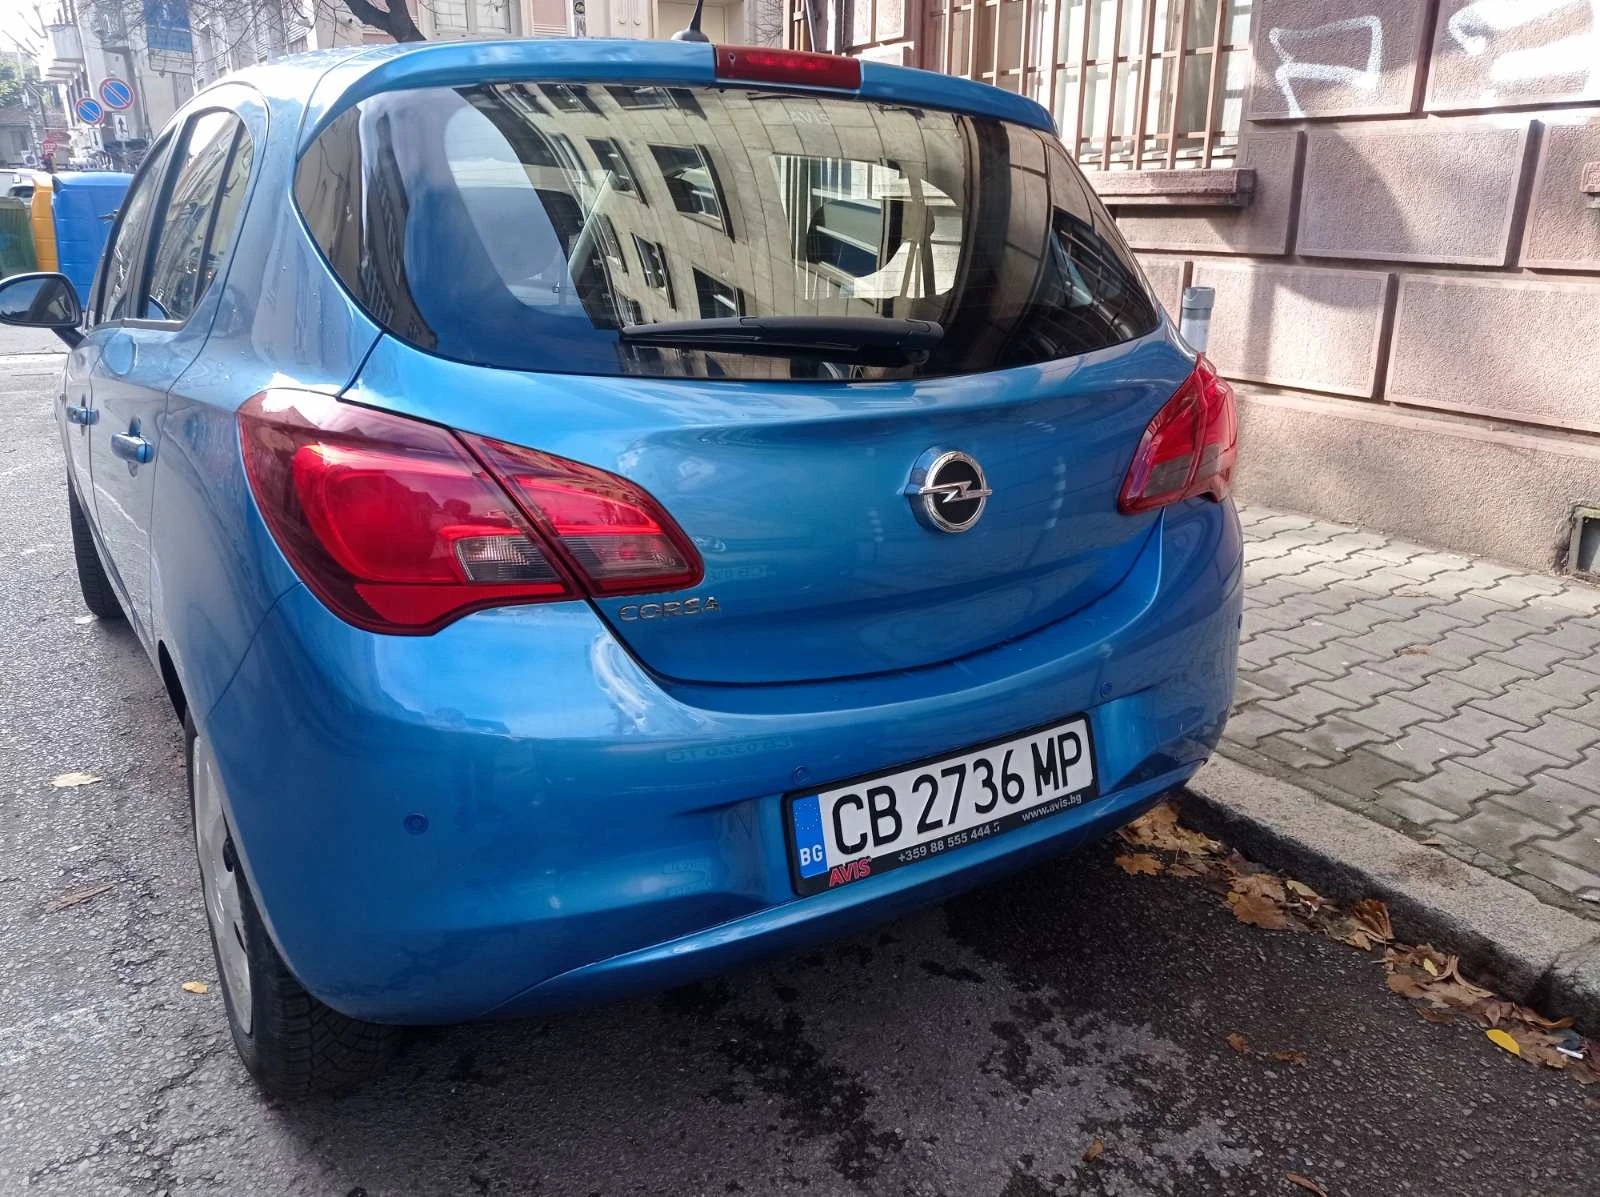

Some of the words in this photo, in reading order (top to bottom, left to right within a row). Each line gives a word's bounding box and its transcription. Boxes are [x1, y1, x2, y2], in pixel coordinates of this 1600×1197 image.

[619, 596, 720, 621] CORSA
[832, 785, 902, 855] CB
[912, 750, 1025, 834] 2736
[1030, 731, 1082, 797] MP
[1021, 794, 1082, 821] www.avis.bg
[800, 844, 823, 866] BG
[898, 846, 927, 862] +359
[930, 840, 944, 853] 88
[947, 832, 968, 848] 555
[970, 825, 990, 839] 444
[829, 859, 870, 887] AVIS
